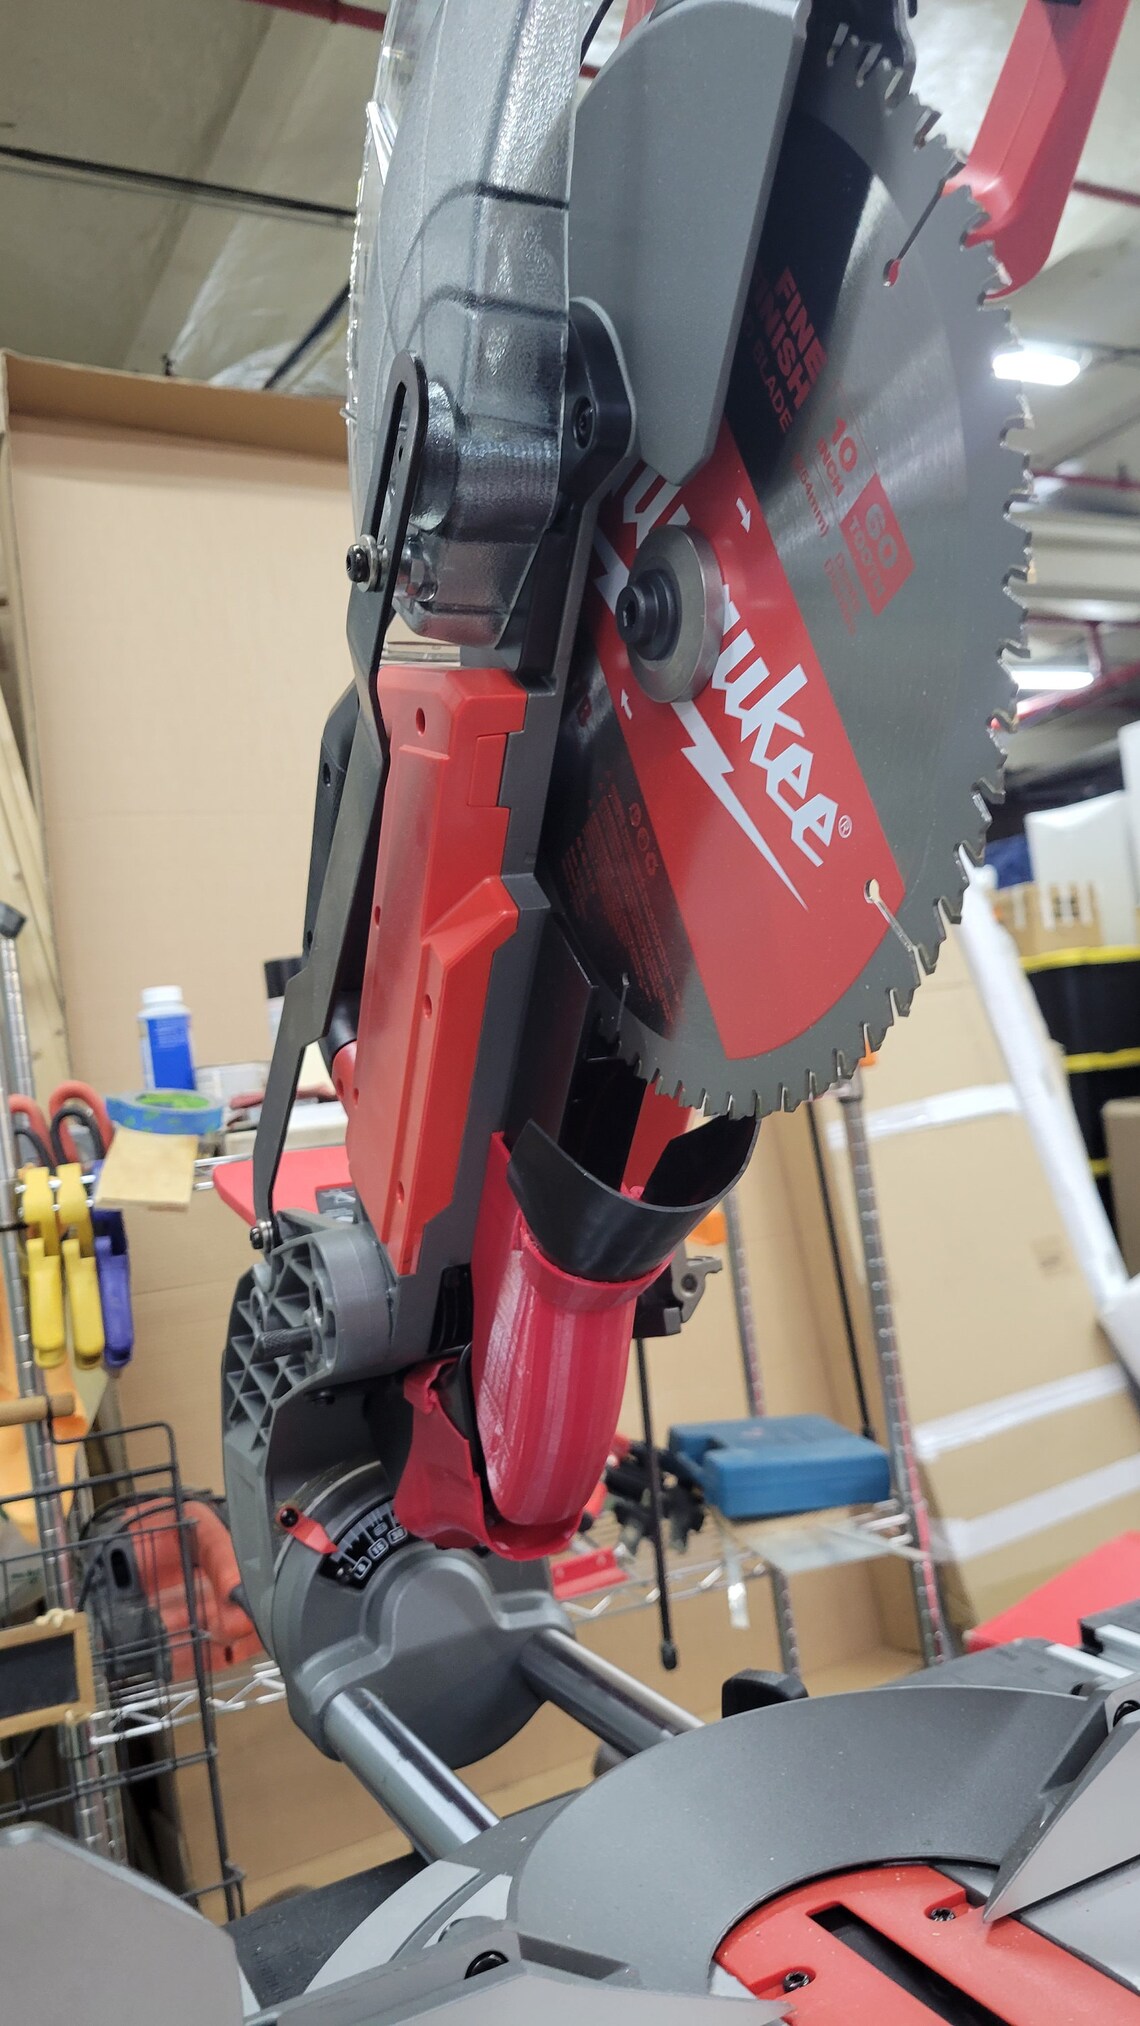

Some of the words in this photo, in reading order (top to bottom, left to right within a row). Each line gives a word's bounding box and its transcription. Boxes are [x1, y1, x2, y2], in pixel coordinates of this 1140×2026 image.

[775, 265, 828, 385] FINE
[752, 338, 793, 434] BLADE
[816, 436, 845, 498] INCH
[831, 416, 858, 473] 10
[864, 503, 898, 569] 60
